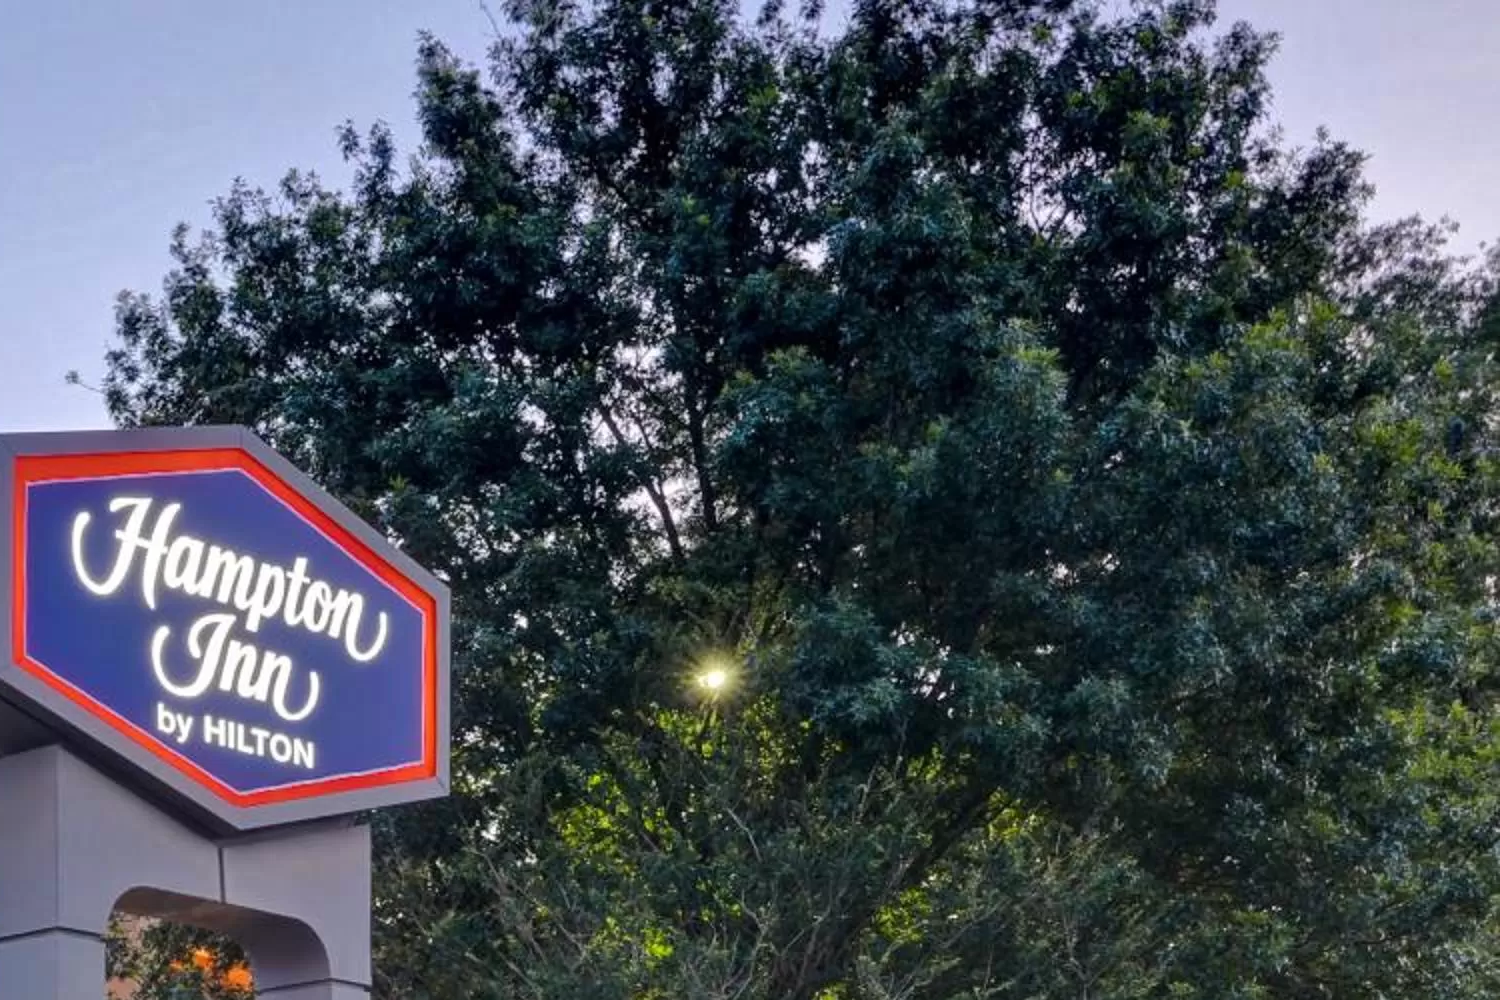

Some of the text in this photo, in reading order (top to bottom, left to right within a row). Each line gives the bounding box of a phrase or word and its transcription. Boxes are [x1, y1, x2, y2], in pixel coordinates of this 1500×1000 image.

[72, 497, 388, 661] Hampton
[151, 614, 319, 721] Inn
[157, 703, 315, 769] by HILTON
